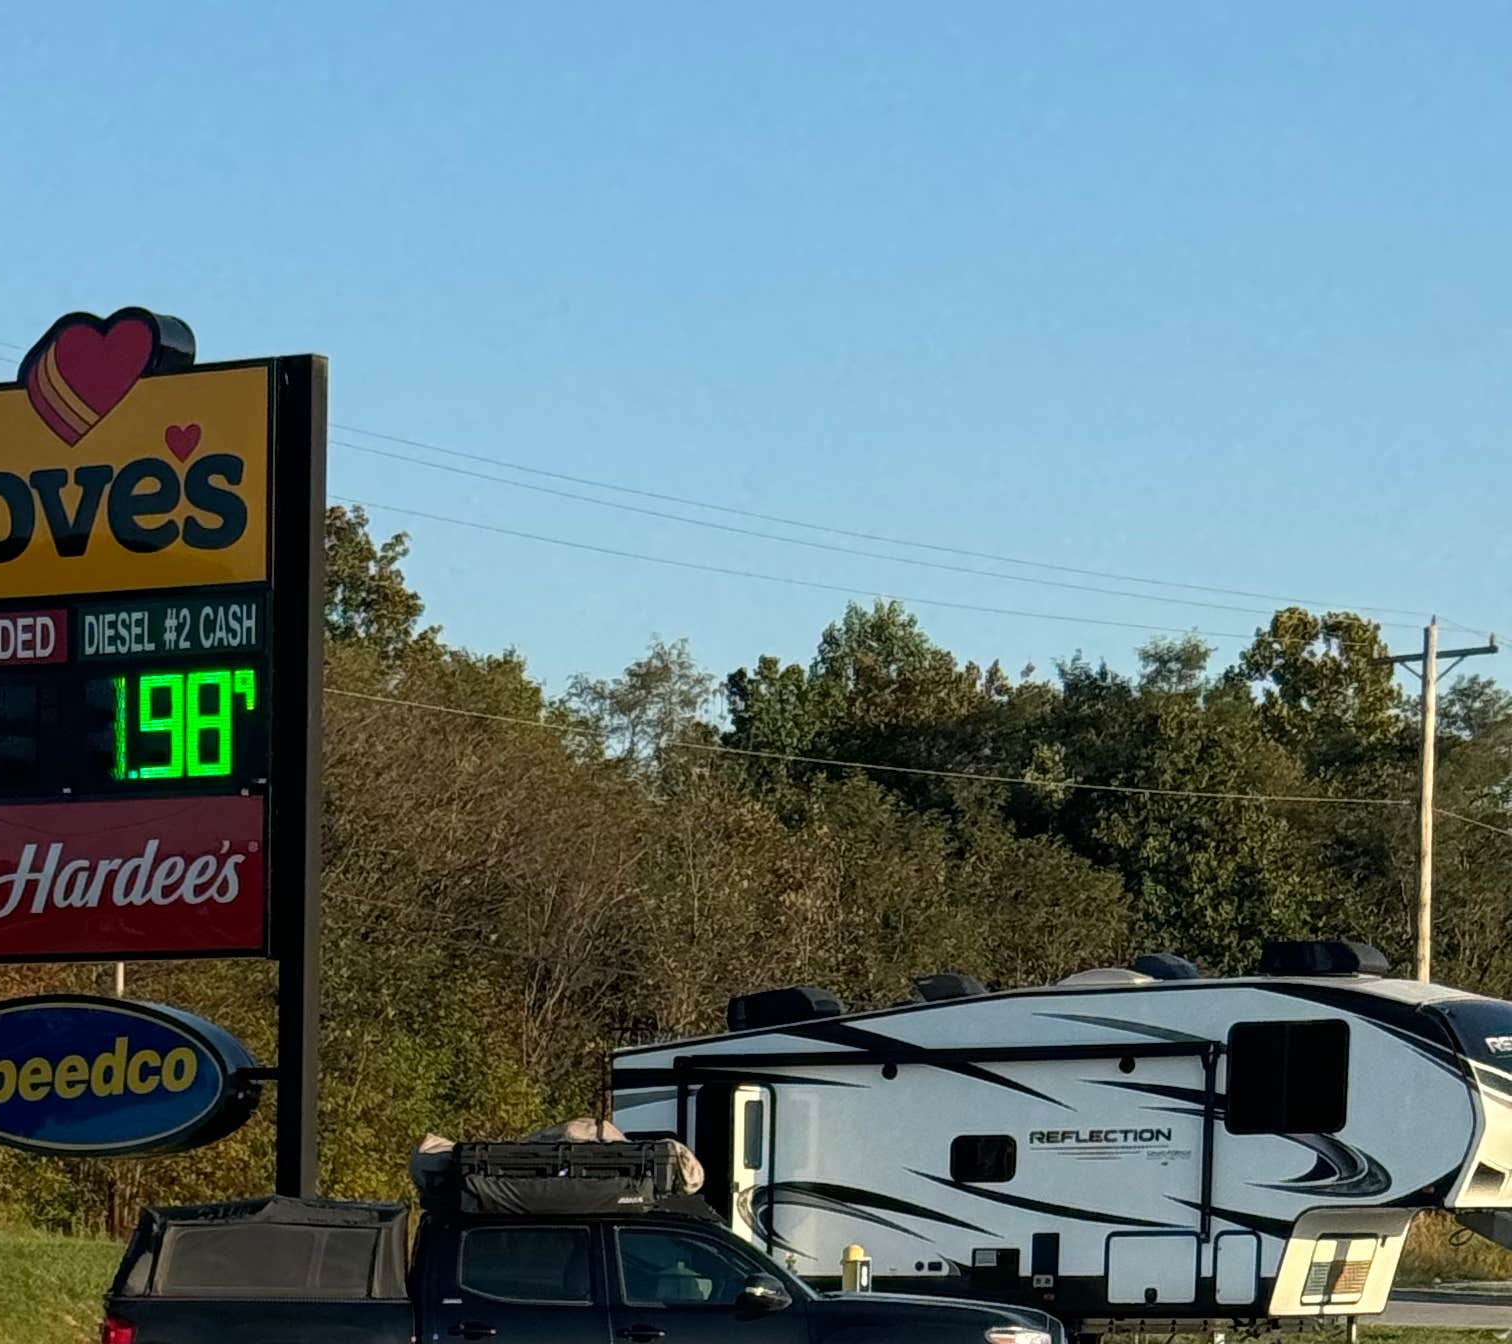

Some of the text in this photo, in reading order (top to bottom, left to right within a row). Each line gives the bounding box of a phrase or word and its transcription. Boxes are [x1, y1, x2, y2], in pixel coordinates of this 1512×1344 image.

[84, 603, 257, 655] DIESEL #2 CASH
[1029, 1127, 1173, 1145] REFLECTION
